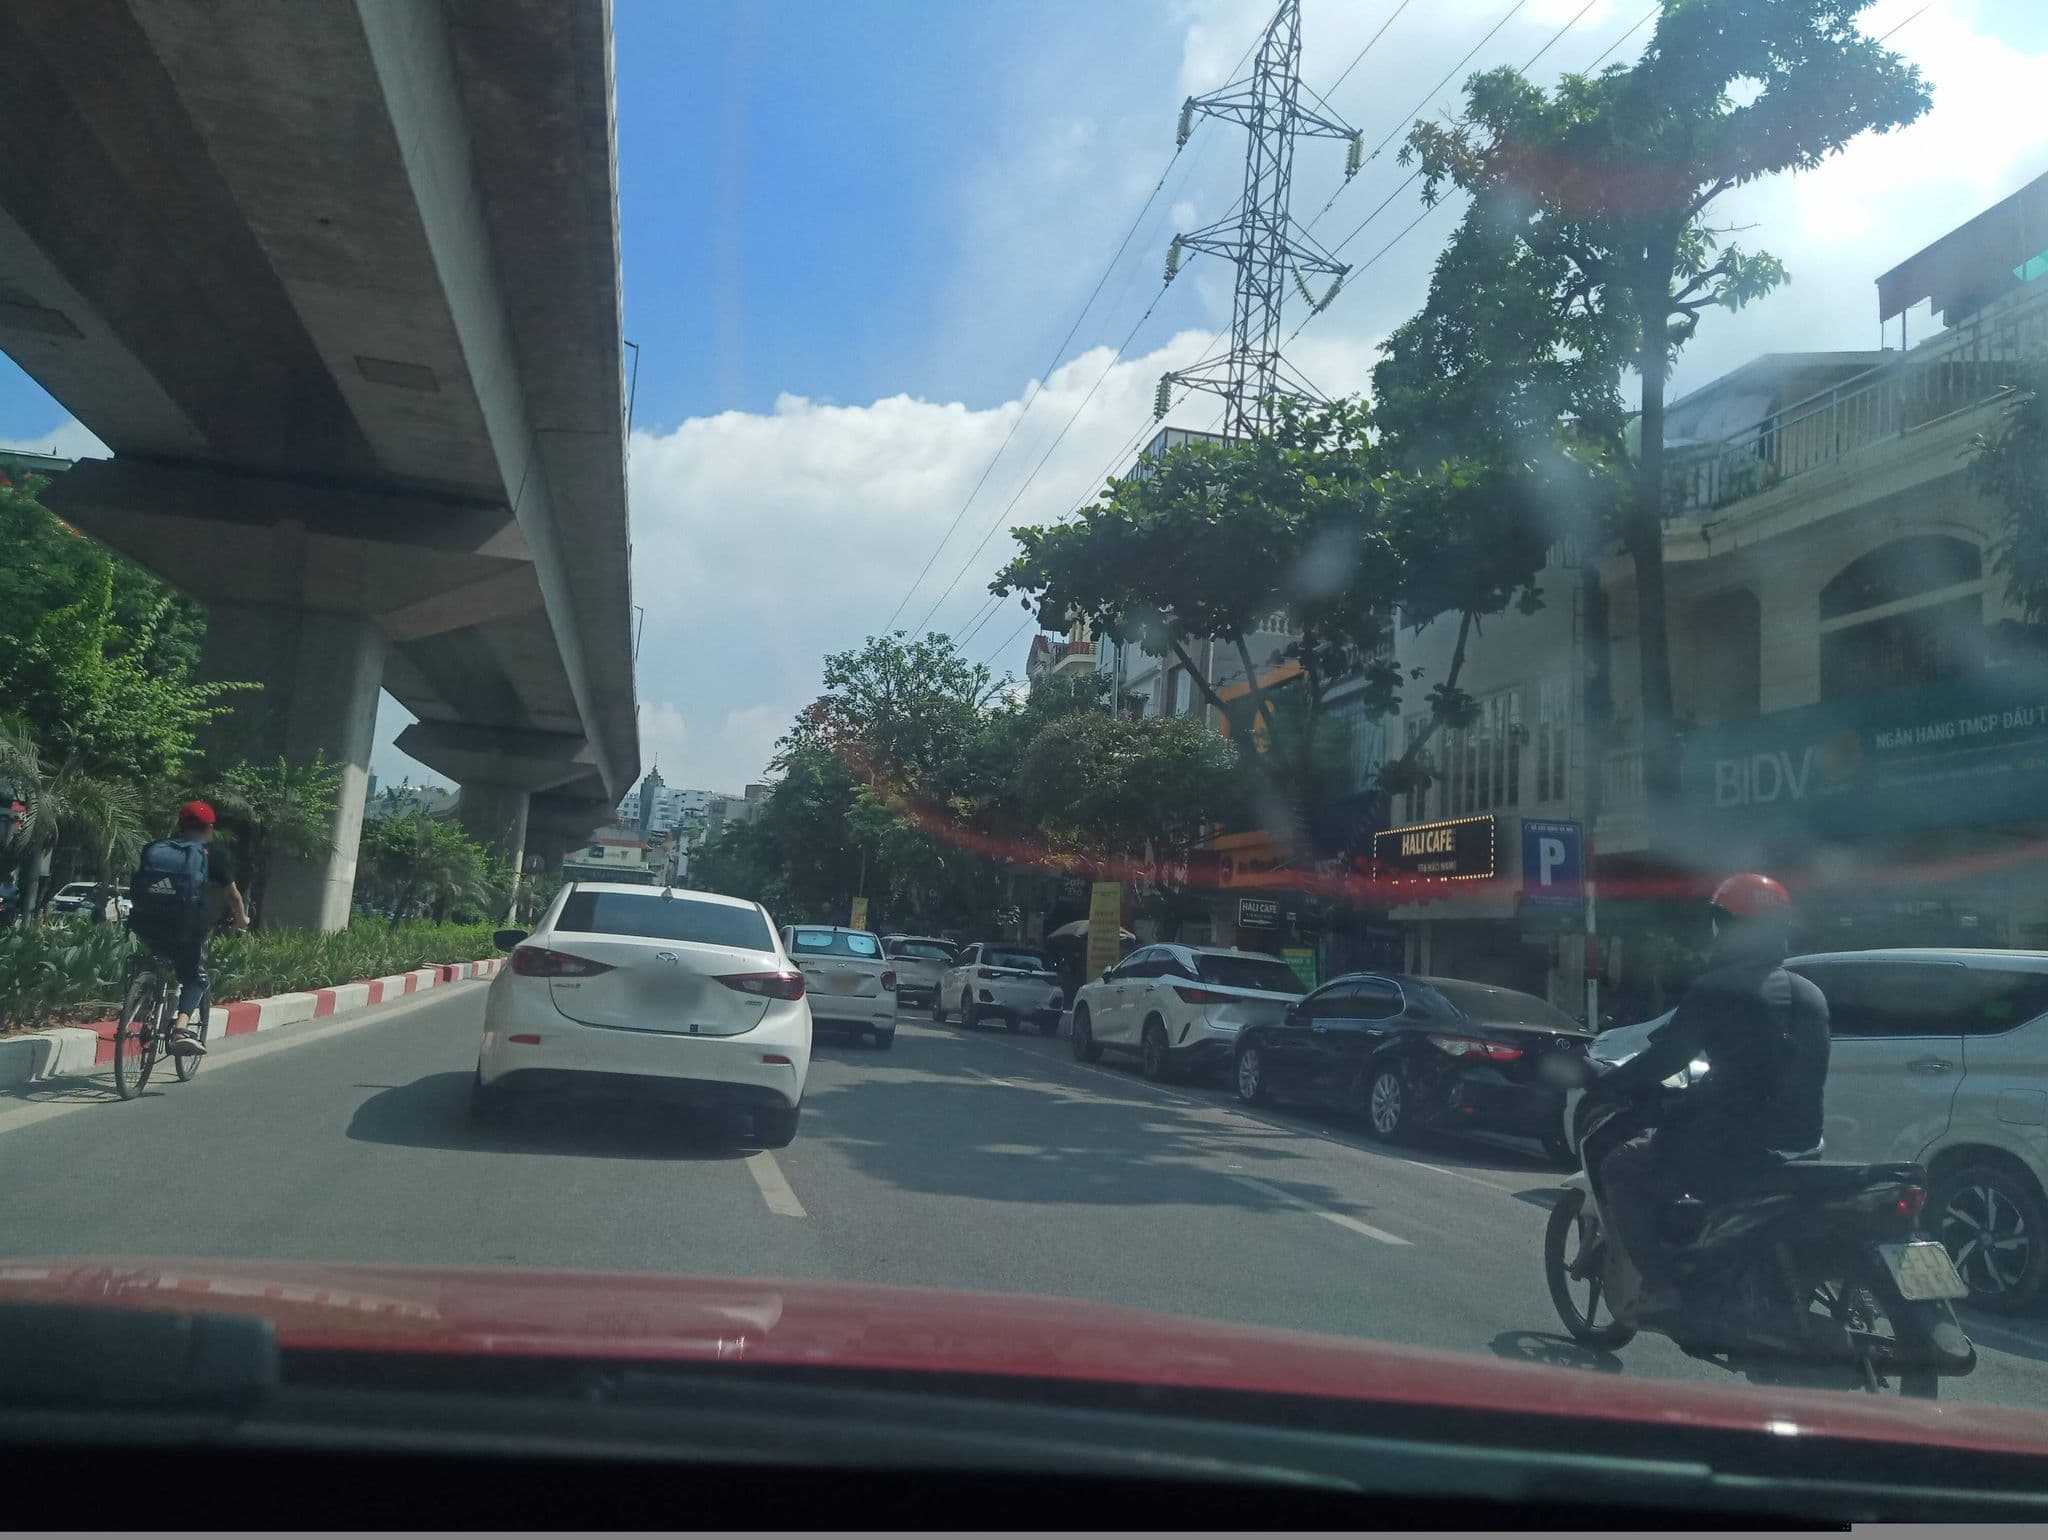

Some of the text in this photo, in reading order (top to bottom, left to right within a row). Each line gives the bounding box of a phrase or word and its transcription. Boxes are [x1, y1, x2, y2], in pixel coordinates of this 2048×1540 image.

[1958, 713, 1998, 737] TMCP
[1714, 746, 1814, 808] BIDV
[1402, 829, 1454, 856] HALI CAFE
[1539, 837, 1566, 887] P
[1242, 902, 1259, 911] HALI
